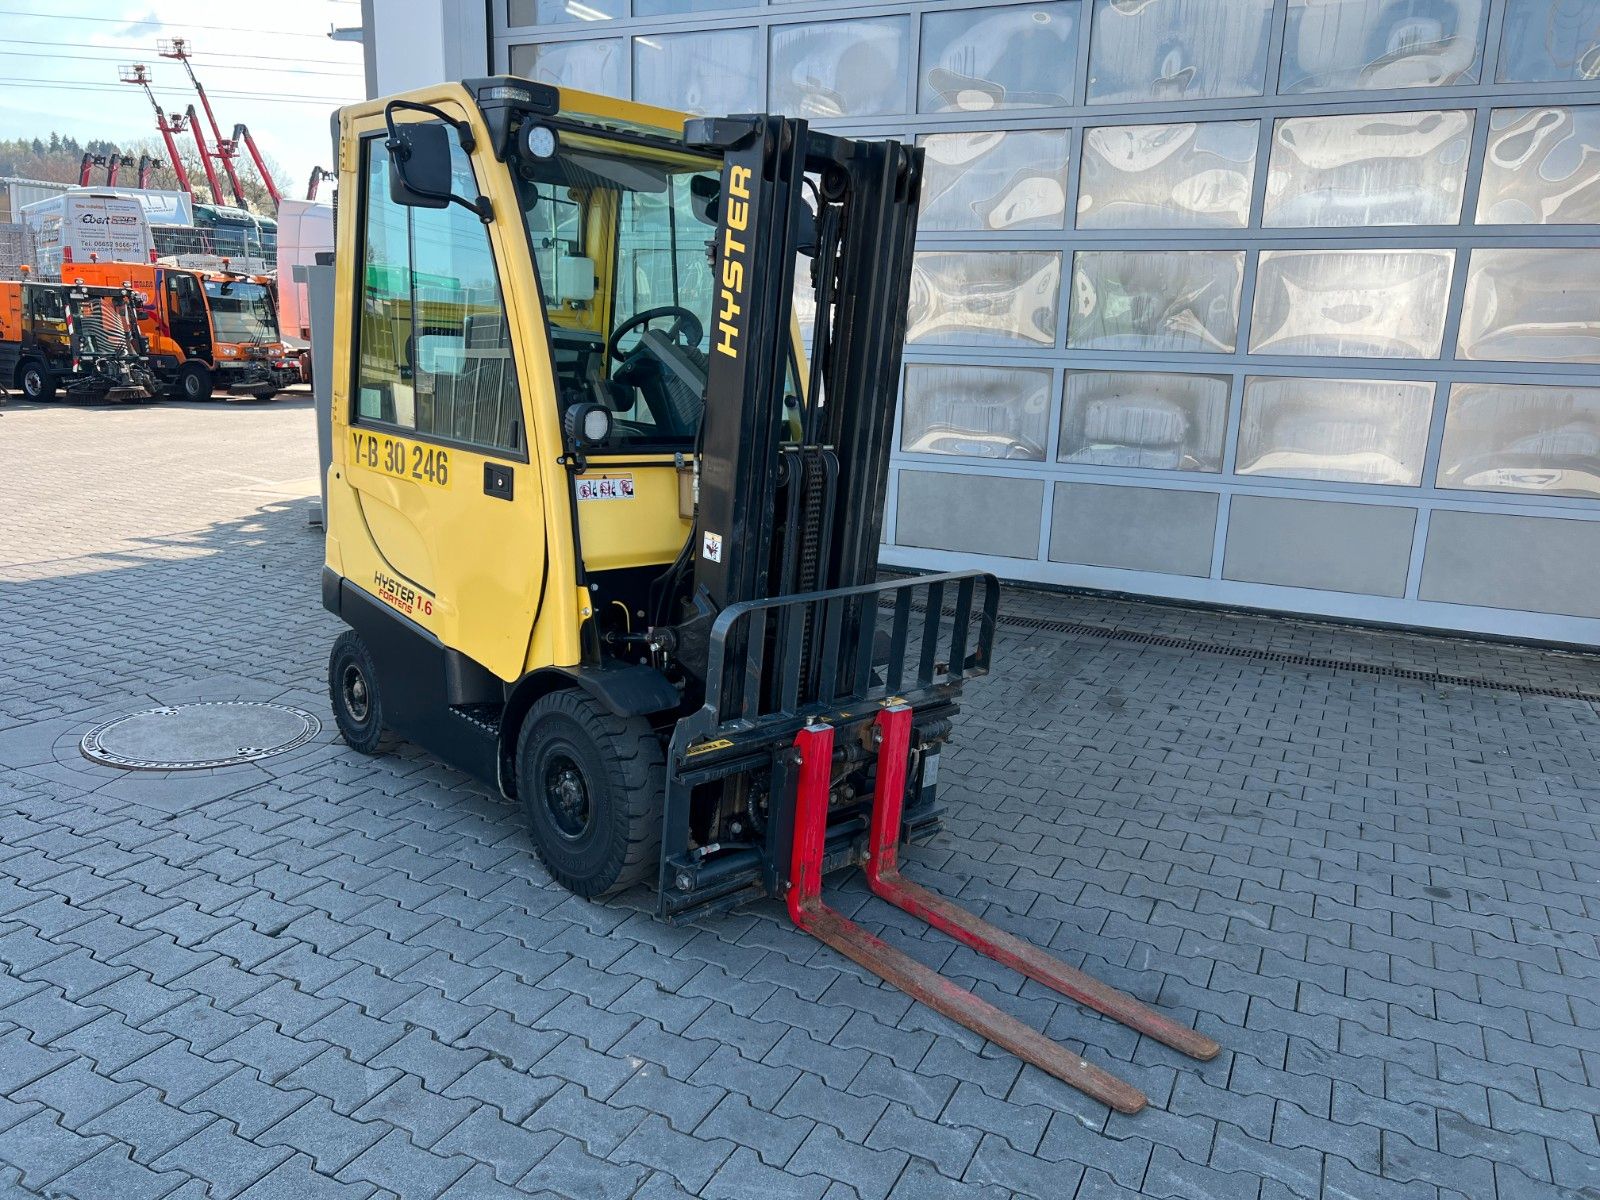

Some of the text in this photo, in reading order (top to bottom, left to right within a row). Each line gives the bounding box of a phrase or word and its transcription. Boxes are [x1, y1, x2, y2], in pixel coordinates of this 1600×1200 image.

[717, 165, 752, 358] HYSTER
[353, 433, 447, 485] Y-B 30 246
[374, 571, 432, 615] HYSTER 1.6
[379, 588, 412, 614] FORTENS
